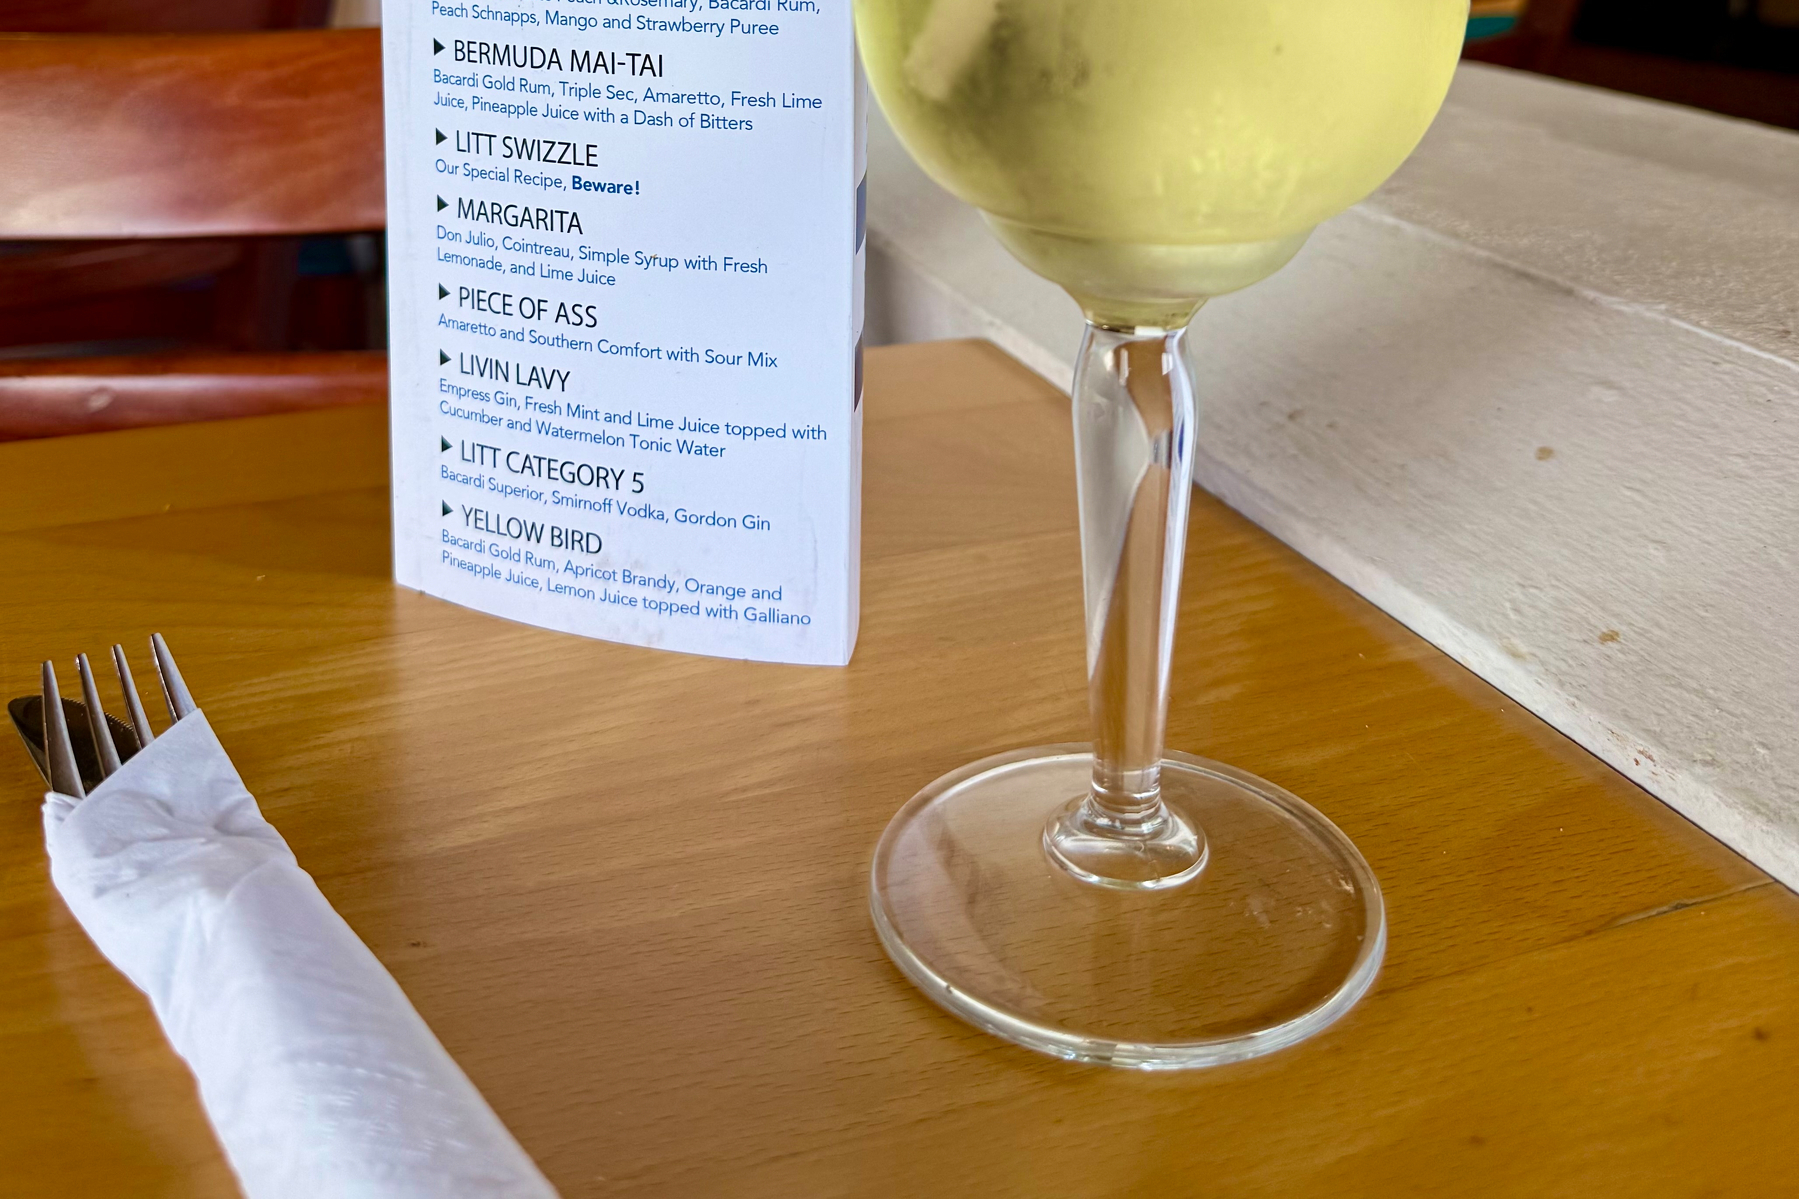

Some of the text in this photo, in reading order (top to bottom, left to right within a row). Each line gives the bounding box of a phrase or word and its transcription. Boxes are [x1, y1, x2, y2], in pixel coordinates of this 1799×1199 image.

[432, 2, 779, 37] Peach Schnapps, Mango and Strawberry Puree
[454, 40, 663, 77] BERMUDA MAI-TAI
[434, 69, 822, 109] Bacardi Gold Rum, Triple Sec, Amaretto, Fresh Lime
[434, 92, 753, 131] Juice, Pineapple Juice with a Dash of Bitters
[456, 130, 598, 168] LITT SWIZZLE
[436, 159, 641, 195] Our Special Recipe, Beware!
[457, 197, 583, 235] MARGARITA
[437, 225, 768, 274] Don Julio, Cointreau, Simple Syrup with Fresh
[437, 248, 616, 286] Lemonade, and Lime Juice
[459, 287, 598, 328] PIECE OF ASS
[438, 313, 778, 368] Amaretto and Southern Comfort with Sour Mix
[460, 352, 571, 392] LIVIN LAVY
[440, 379, 827, 441] Empress Gin, Fresh Mint and Lime Juice topped with
[440, 401, 726, 458] Cucumber and Watermelon Tonic Water
[461, 440, 644, 494] LITT CATEGORY 5
[441, 465, 771, 531] Bacardi Superior, Smirnoff Vodka, Gordon Gin
[462, 504, 603, 555] YELLOW BIRD
[442, 529, 782, 601] Bacardi Gold Rum, Apricot Brandy, Orange and
[442, 550, 811, 626] Pineapple Juice, Lemon Juice topped with Galliano
